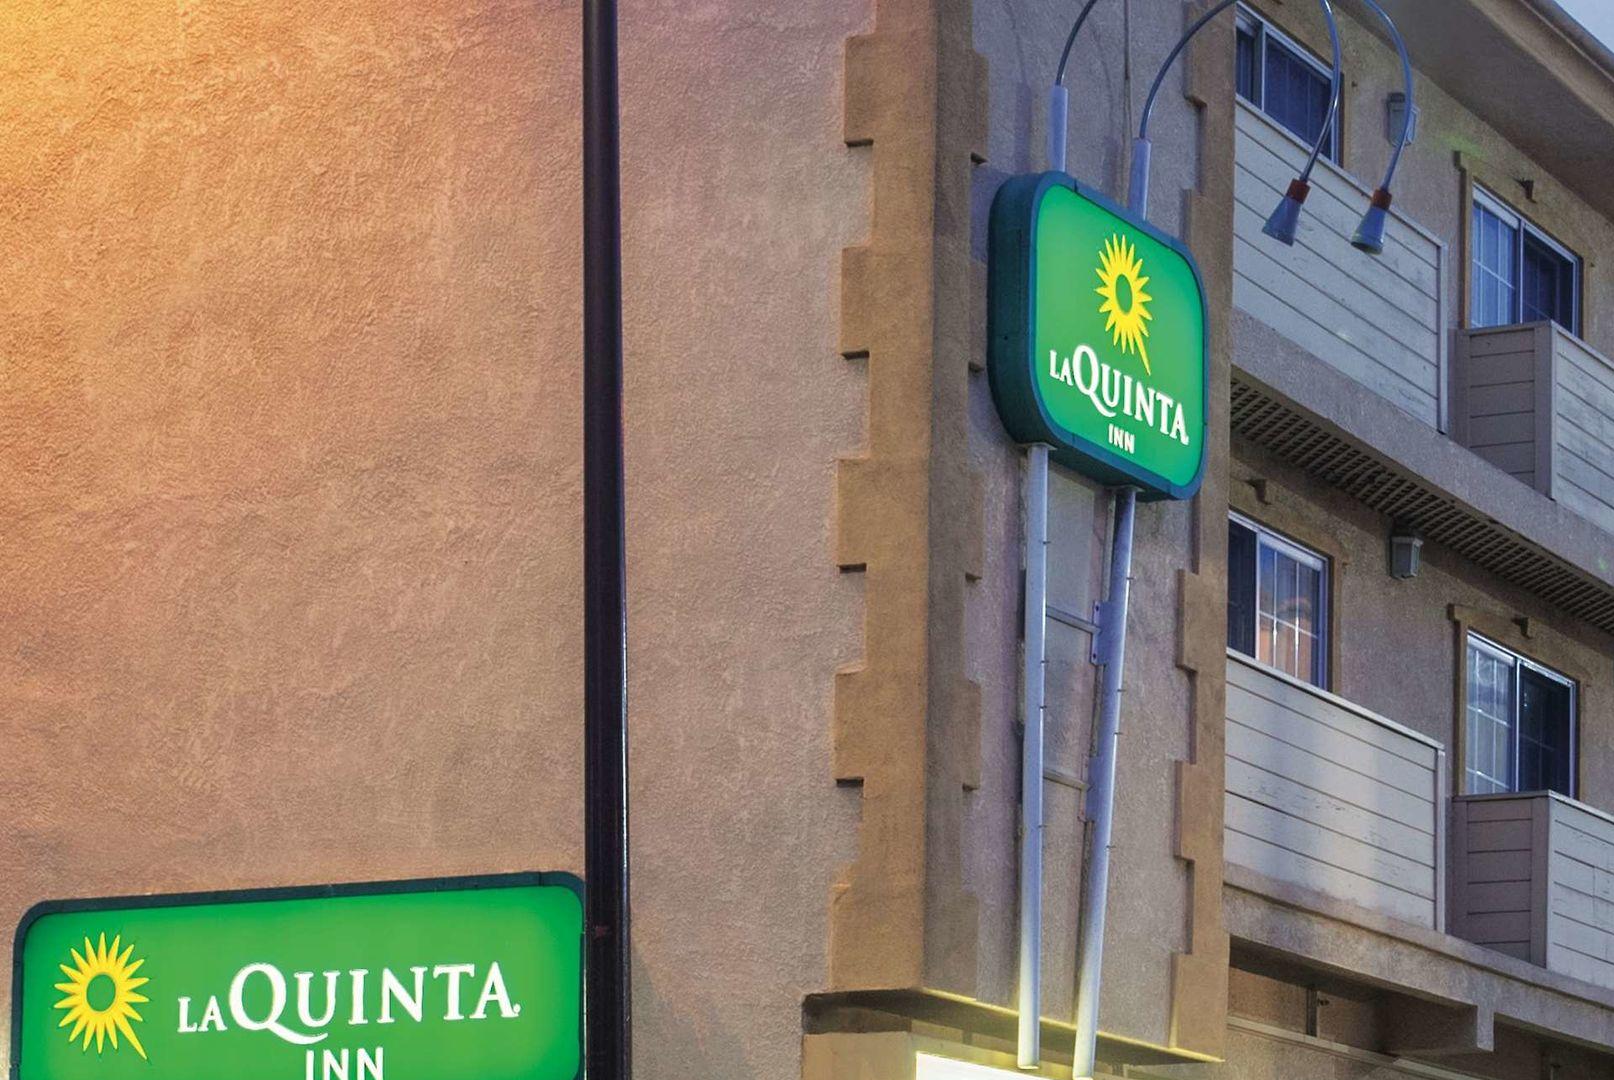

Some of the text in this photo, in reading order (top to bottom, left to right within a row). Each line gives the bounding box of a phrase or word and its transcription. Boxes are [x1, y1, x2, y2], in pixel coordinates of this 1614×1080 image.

[1049, 344, 1190, 445] LA QUINTA
[1108, 423, 1135, 454] INN
[177, 961, 521, 1045] LA QUINTA
